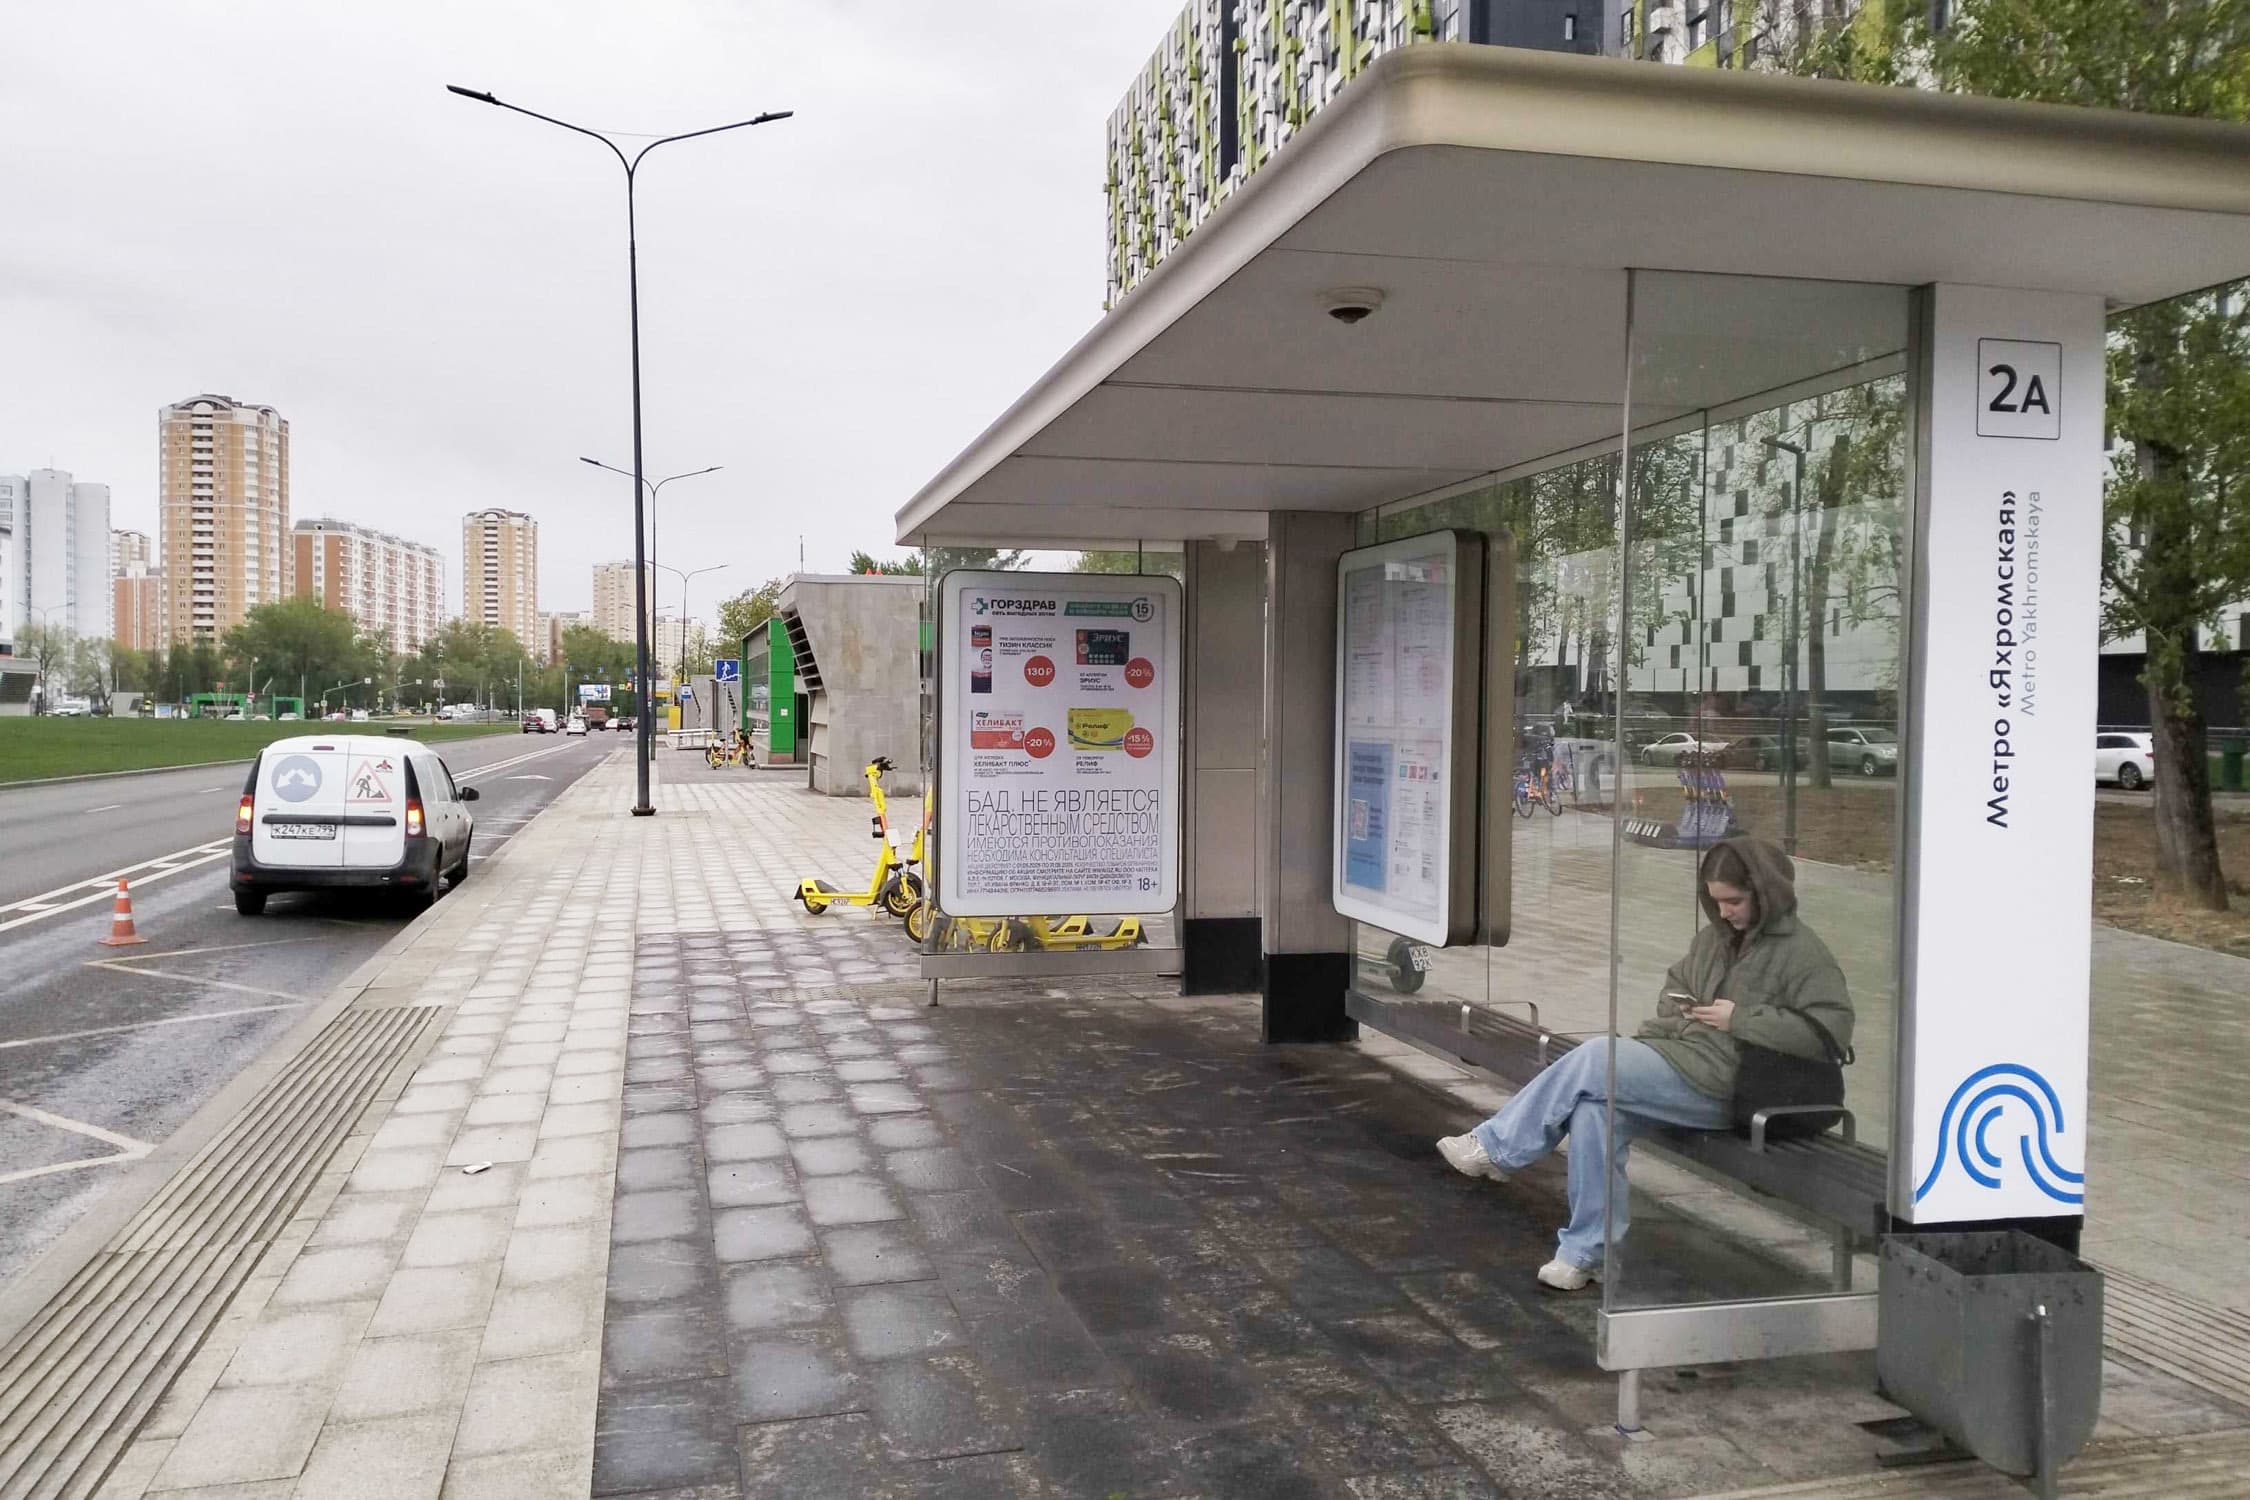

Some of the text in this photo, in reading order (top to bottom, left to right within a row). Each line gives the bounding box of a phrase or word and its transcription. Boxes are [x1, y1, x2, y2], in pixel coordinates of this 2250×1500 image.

[990, 599, 1056, 612] ГОРЗДРАВ
[1136, 603, 1149, 614] 15
[2020, 490, 2041, 717] Metro Yakhromskaya
[1986, 489, 2018, 829] Метро «Яхромская»
[1027, 667, 1045, 676] 130
[975, 719, 1023, 727] ХЕЛИБАКТ
[1022, 790, 1048, 812] НЕ
[1054, 789, 1159, 812] ЯВЛЯЕТСЯ
[968, 812, 1159, 836] ЛЕКАРСТВЕННЫМ СРЕДСТВОМ
[967, 835, 1158, 849] ИМЕЮТСЯ ПРОТИВОПОКАЗАНИЯ
[967, 847, 1158, 862] НЕОБХОДИМА КОНСУЛЬТАЦИЯ СПЕЦИАЛИСТА
[1137, 877, 1158, 891] 18+
